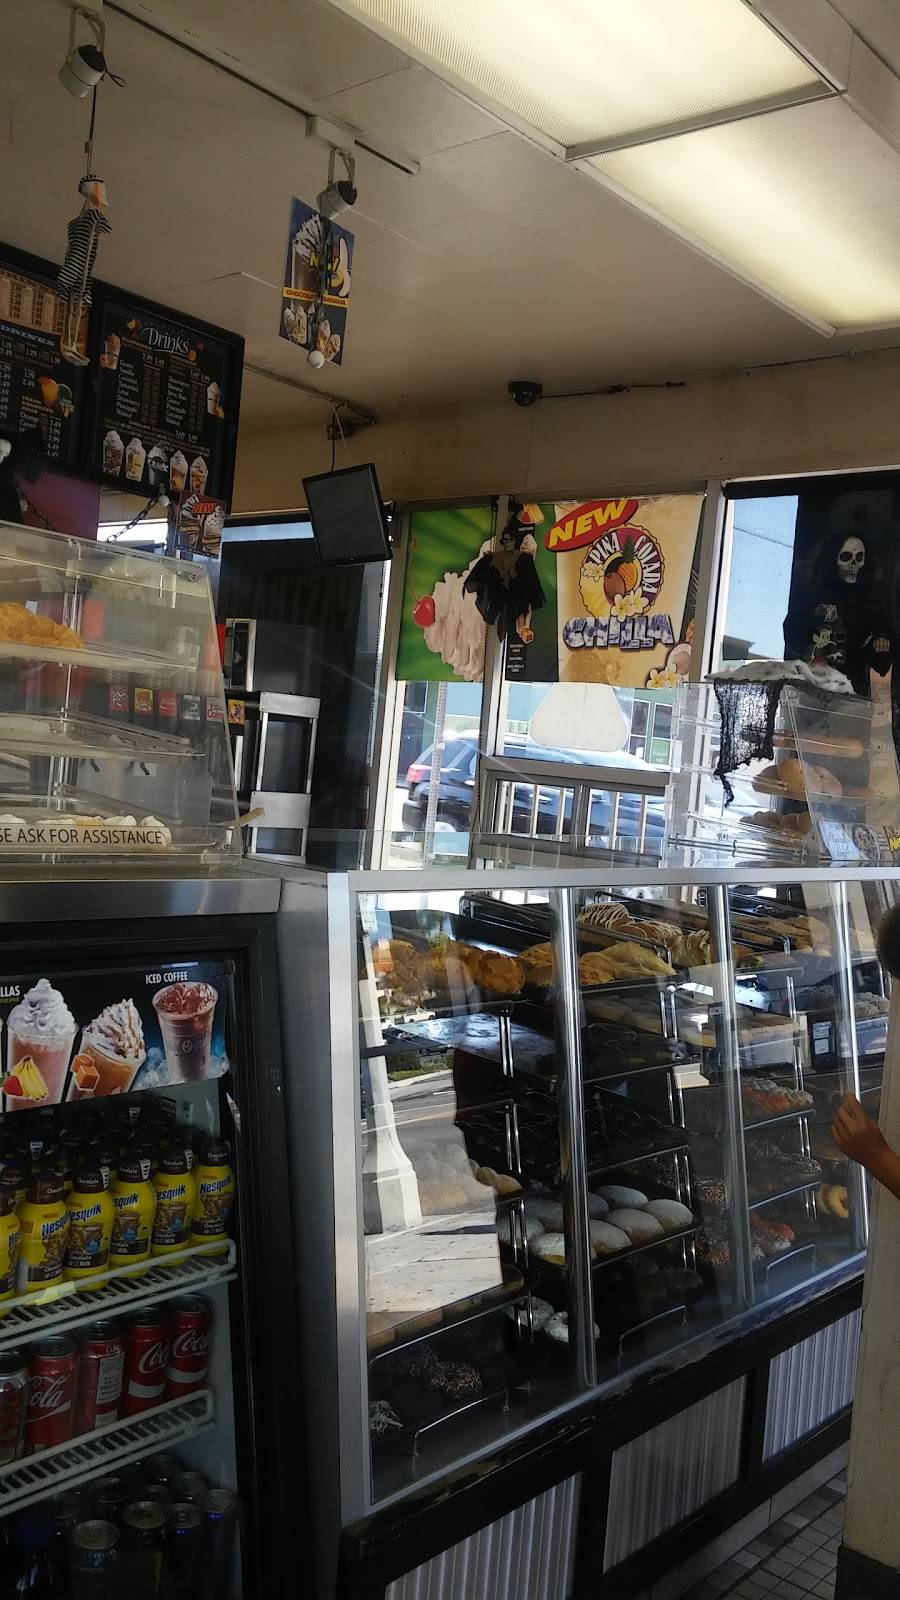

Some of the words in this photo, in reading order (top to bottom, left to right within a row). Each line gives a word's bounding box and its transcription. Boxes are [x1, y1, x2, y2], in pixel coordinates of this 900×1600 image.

[141, 327, 190, 354] Drinks
[193, 503, 215, 513] NEW
[549, 498, 629, 548] NEW
[633, 535, 661, 593] COLADA
[563, 614, 674, 649] CHILLA
[17, 828, 47, 843] ASK
[50, 829, 79, 843] FOR
[83, 829, 164, 845] ASSISTANCE
[145, 973, 163, 985] ICED
[164, 971, 189, 983] COFFEE
